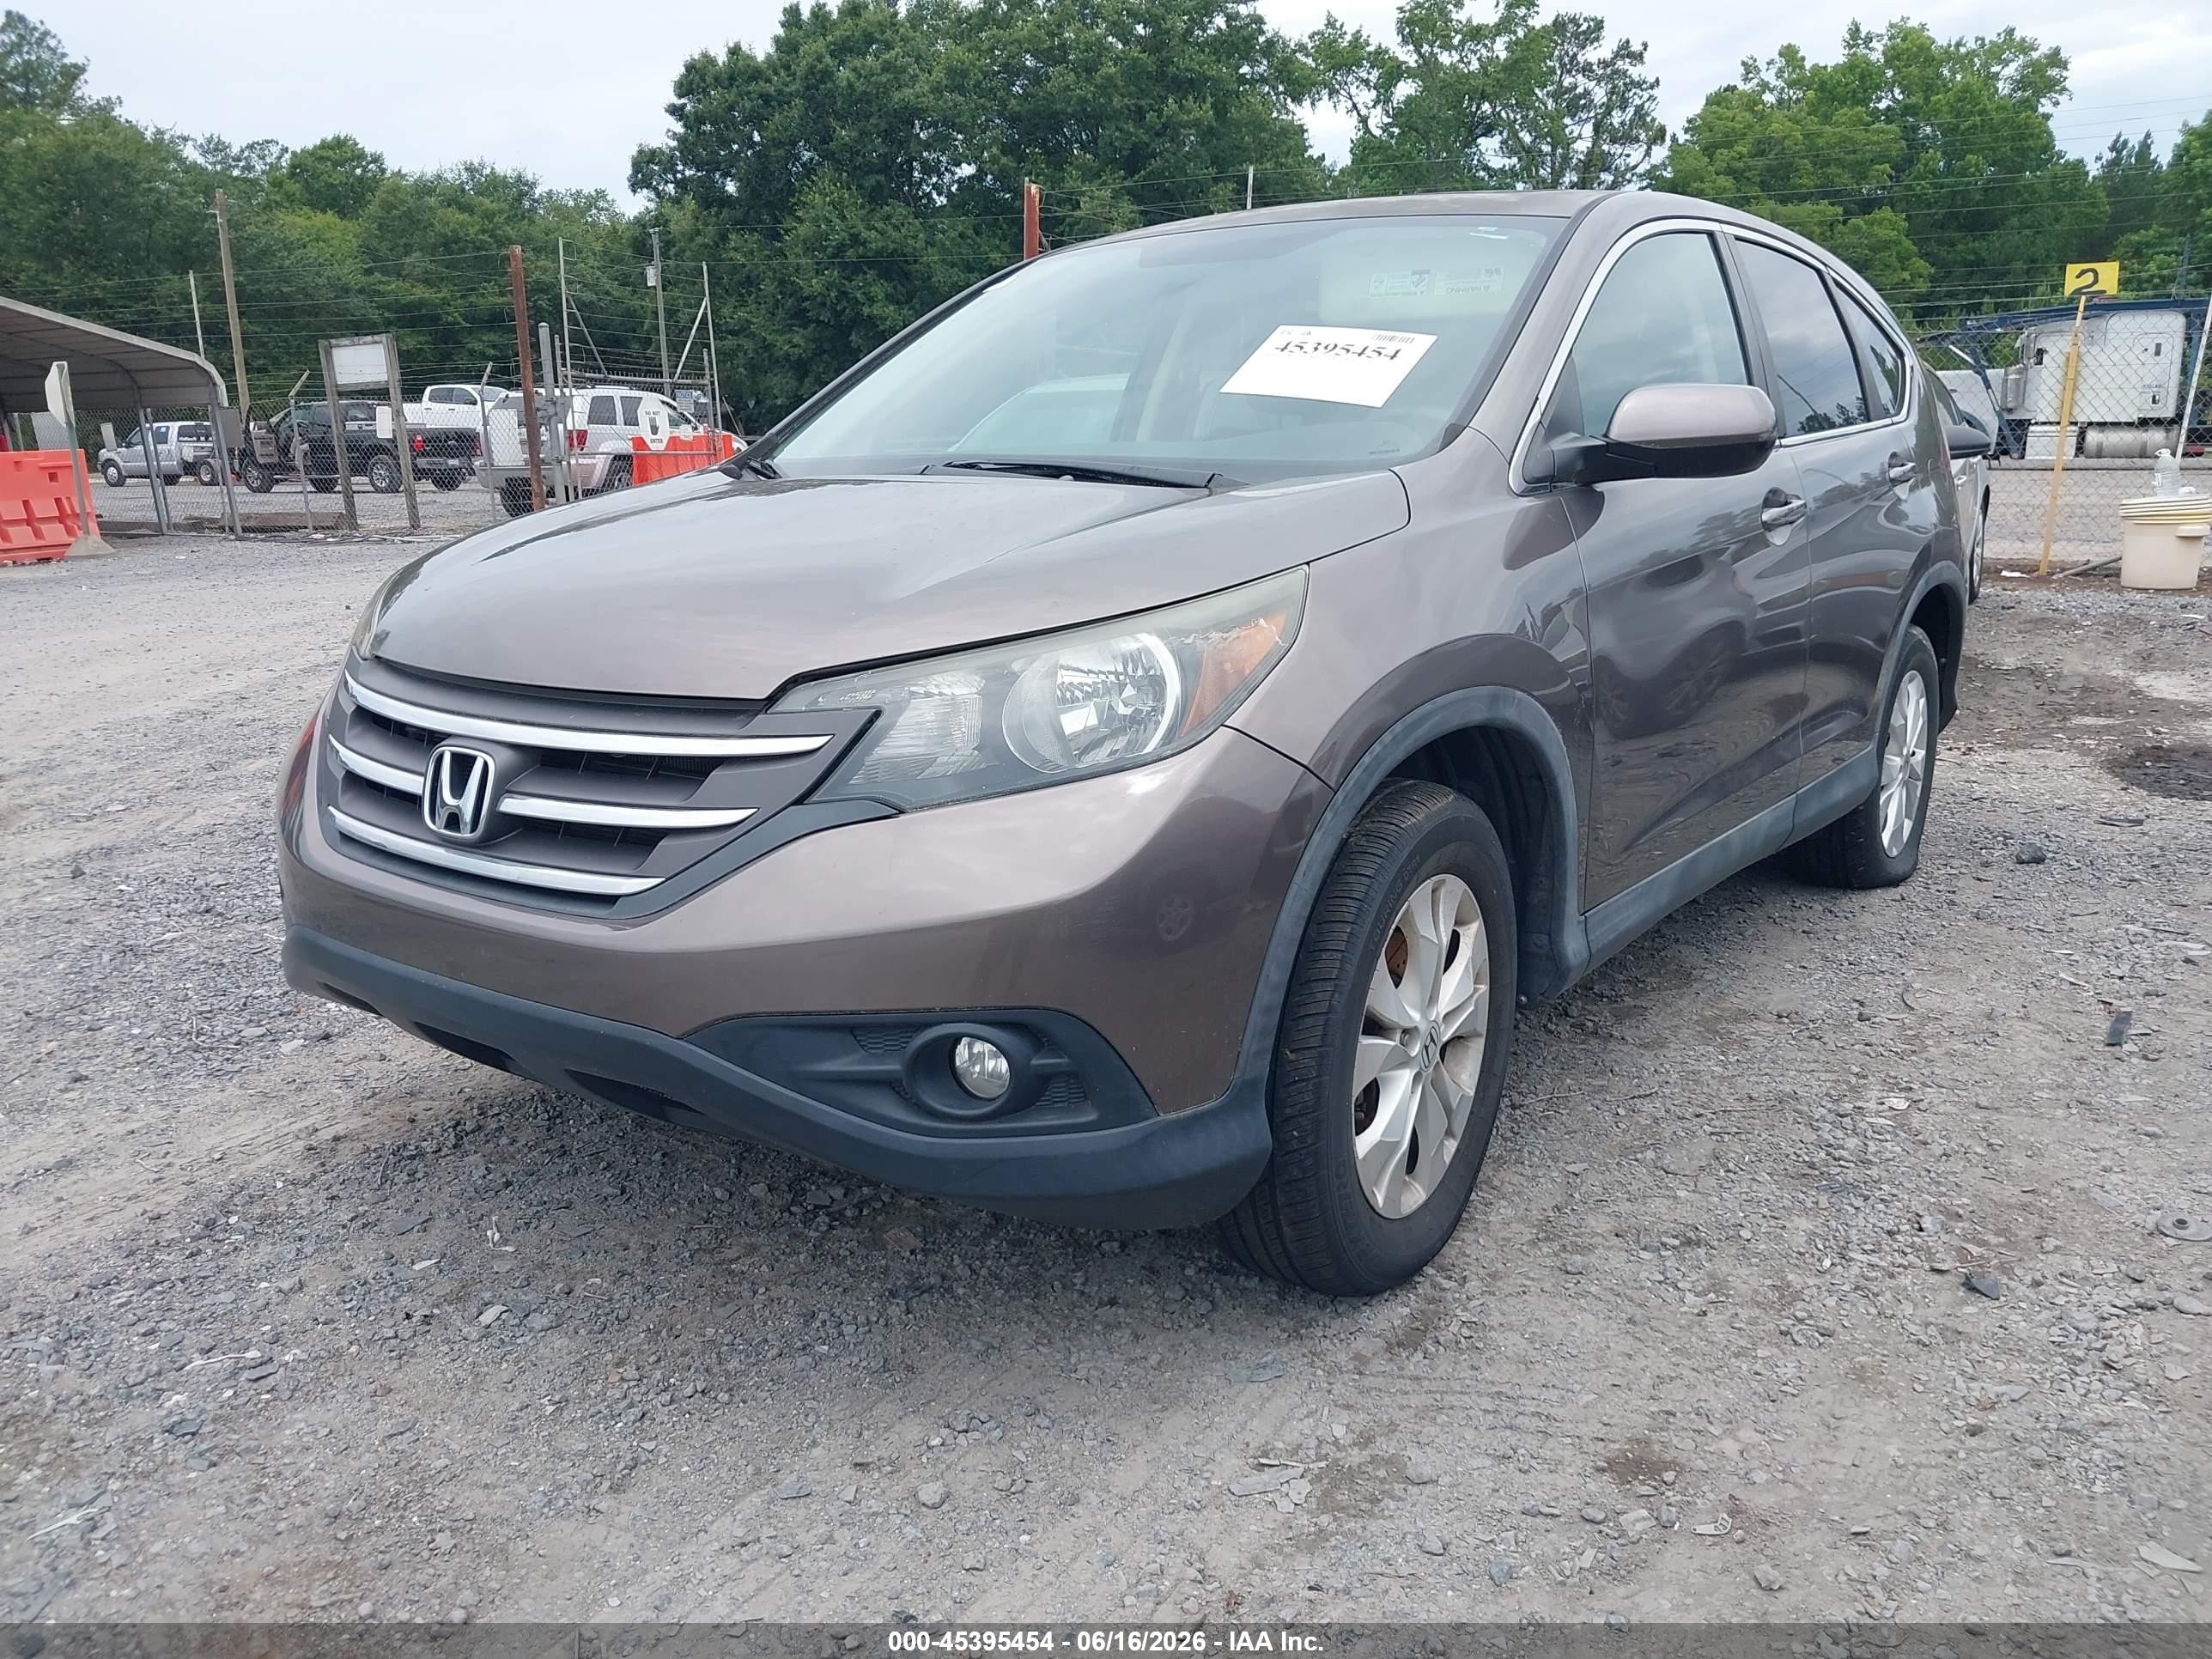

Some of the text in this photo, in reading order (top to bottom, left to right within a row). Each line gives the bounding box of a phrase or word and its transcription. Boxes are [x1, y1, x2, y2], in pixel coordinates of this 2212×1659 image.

[2069, 268, 2106, 295] 2
[1274, 341, 1402, 361] 45395454
[1368, 878, 1404, 951] TOURING
